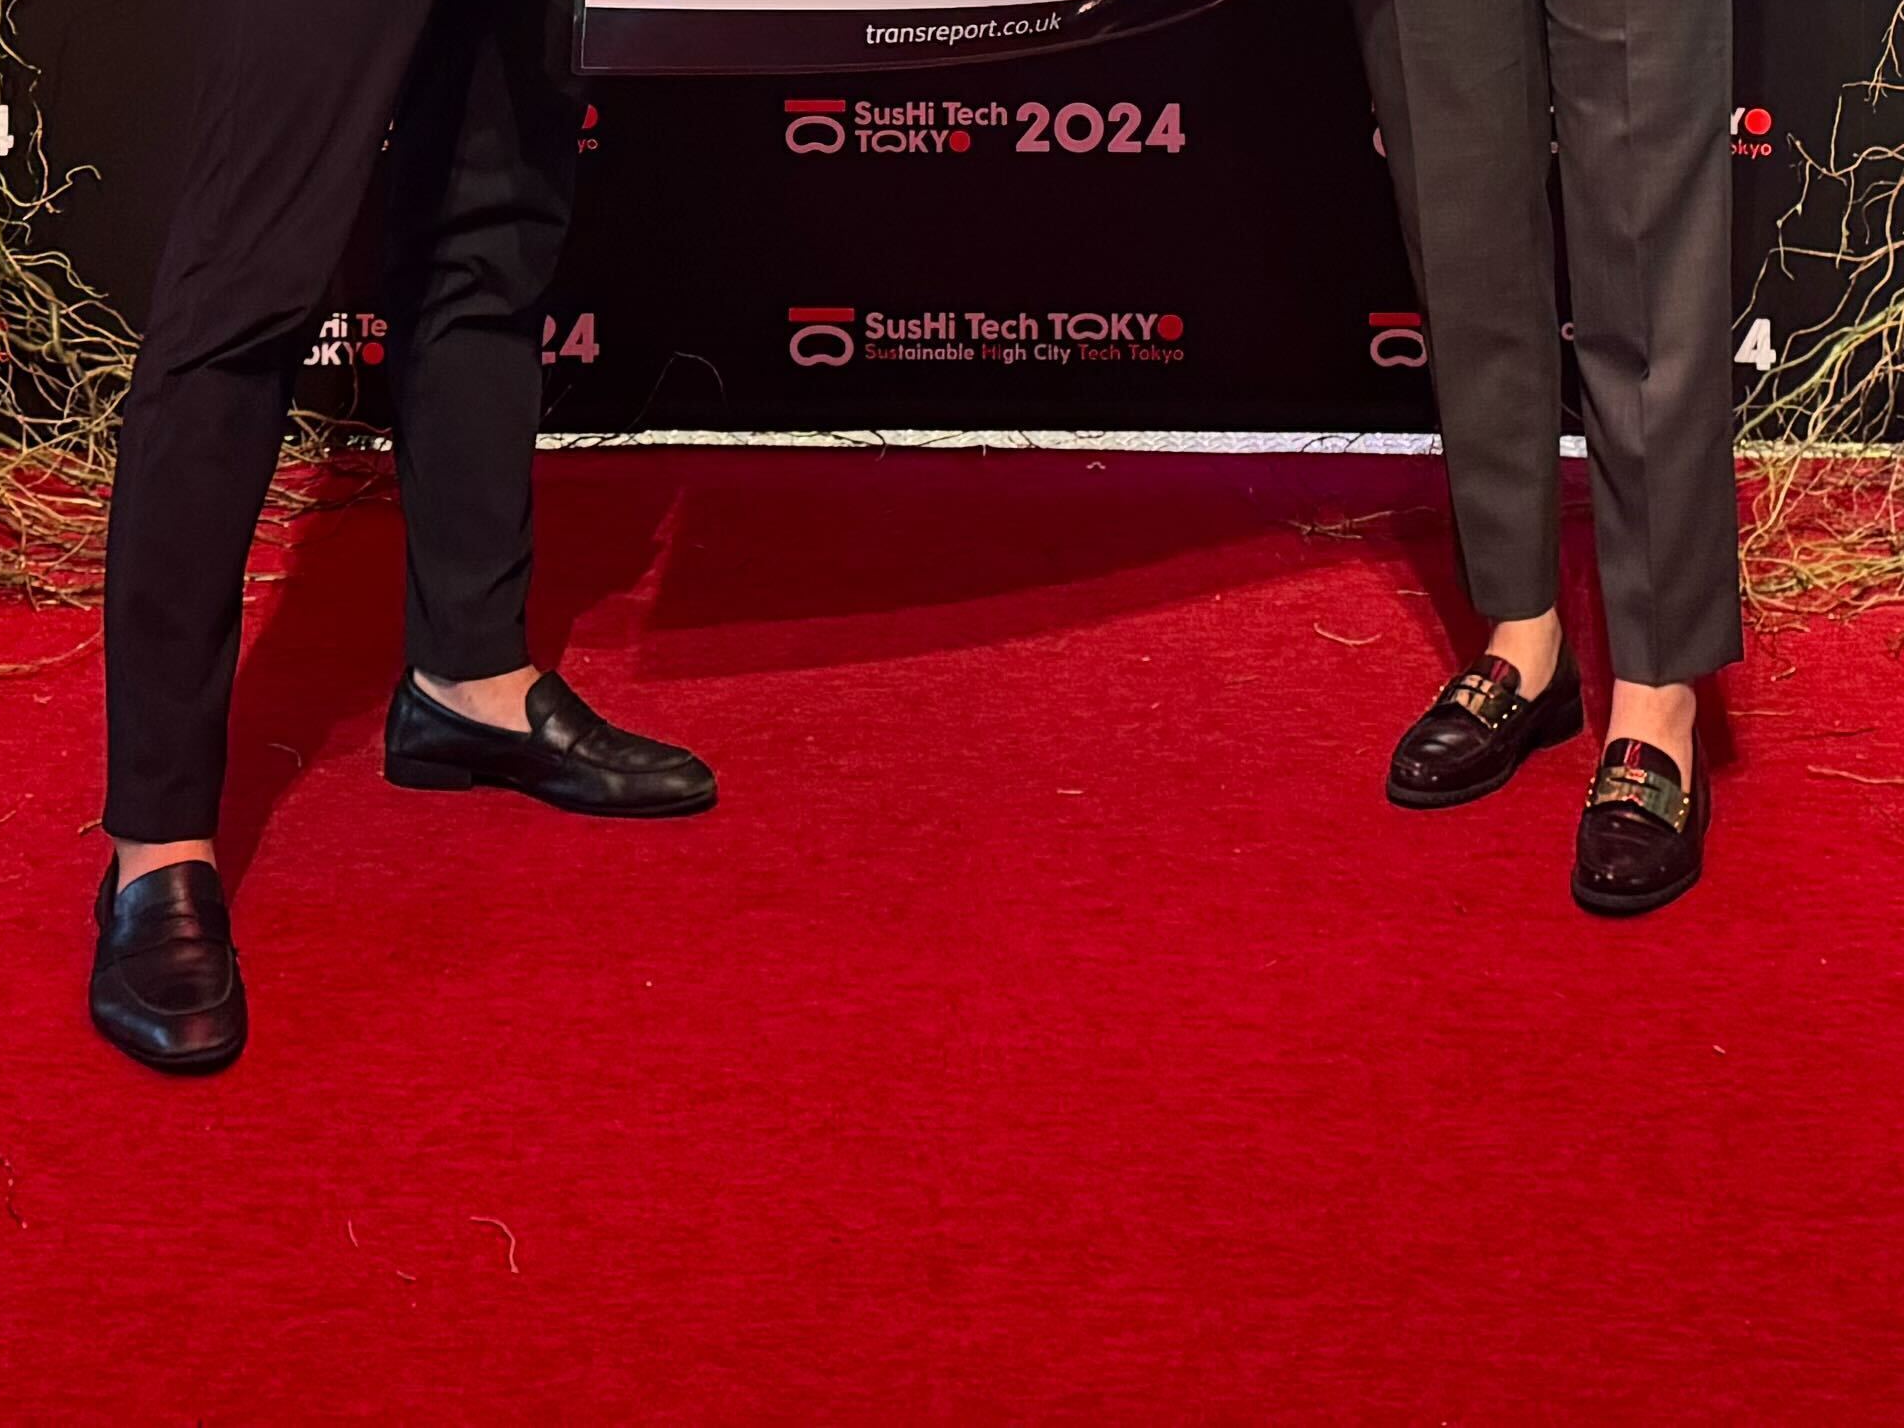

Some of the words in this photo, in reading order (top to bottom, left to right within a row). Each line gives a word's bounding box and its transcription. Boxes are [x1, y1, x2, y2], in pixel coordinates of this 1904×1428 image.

[865, 12, 1062, 45] transreport.co.uk
[855, 101, 934, 125] SusHi
[943, 102, 1007, 125] Tech
[1016, 102, 1185, 152] 2024
[855, 130, 970, 152] TOKYO
[866, 312, 955, 339] SusHi
[965, 313, 1038, 339] Tech
[1048, 313, 1183, 340] TOKYO
[866, 343, 974, 360] Sustainable
[982, 343, 1026, 364] High
[1034, 344, 1071, 364] City
[1078, 344, 1120, 360] Tech
[1128, 344, 1184, 364] Tokyo
